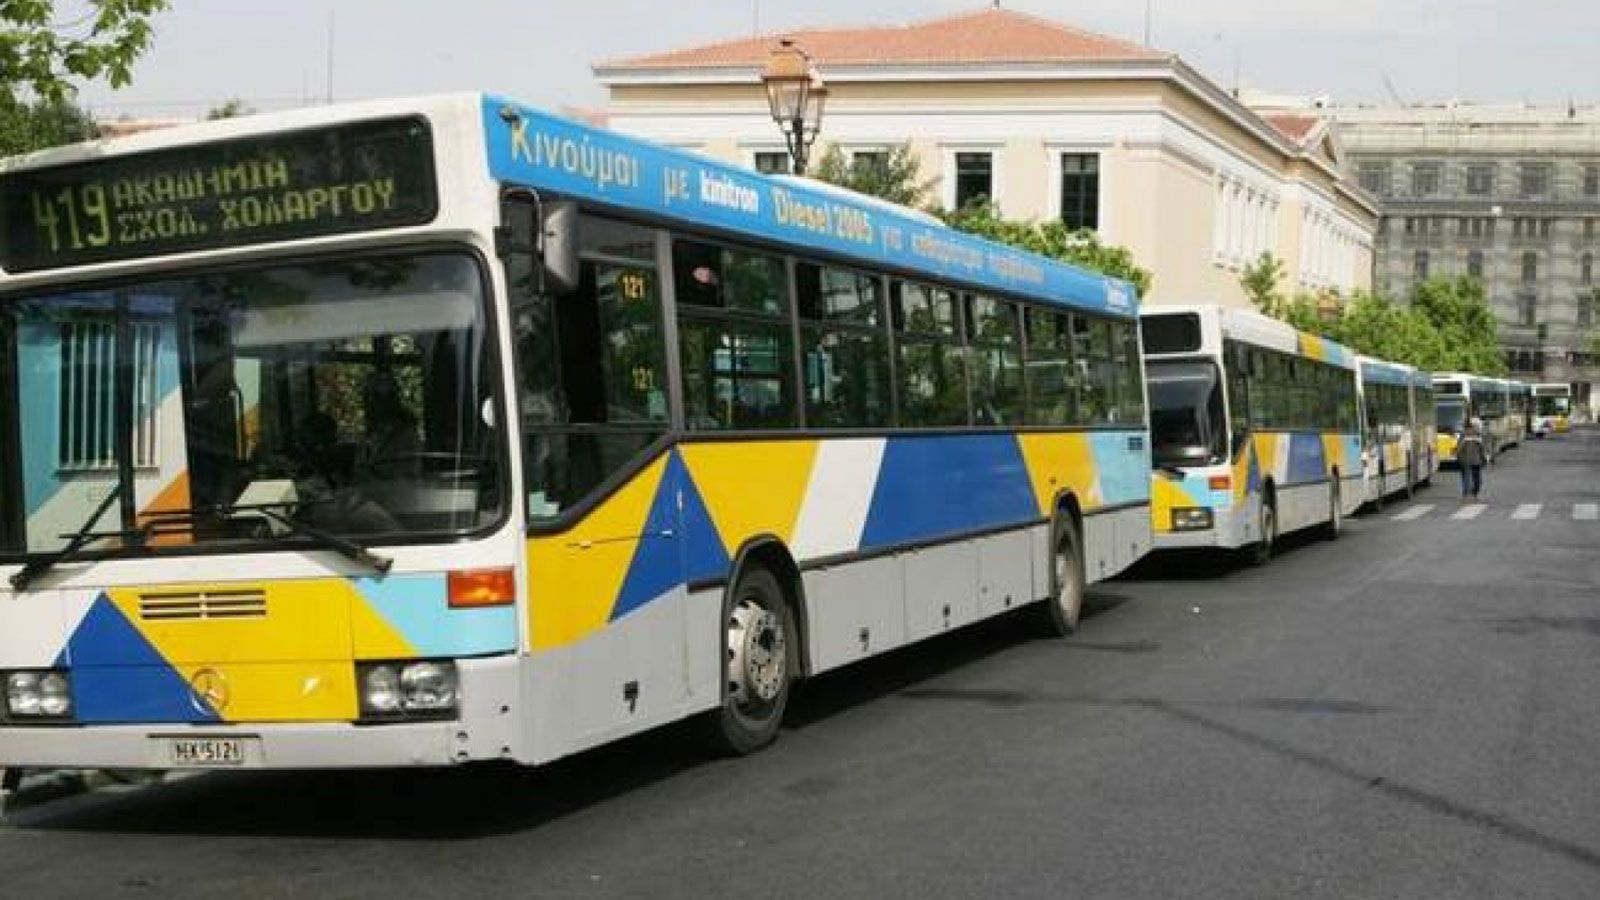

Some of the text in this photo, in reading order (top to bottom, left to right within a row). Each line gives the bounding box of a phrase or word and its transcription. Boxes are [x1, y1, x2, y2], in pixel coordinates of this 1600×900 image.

[31, 184, 111, 252] 419
[510, 115, 640, 189] Κινούμαι
[663, 166, 690, 206] με
[771, 187, 833, 233] Diesel
